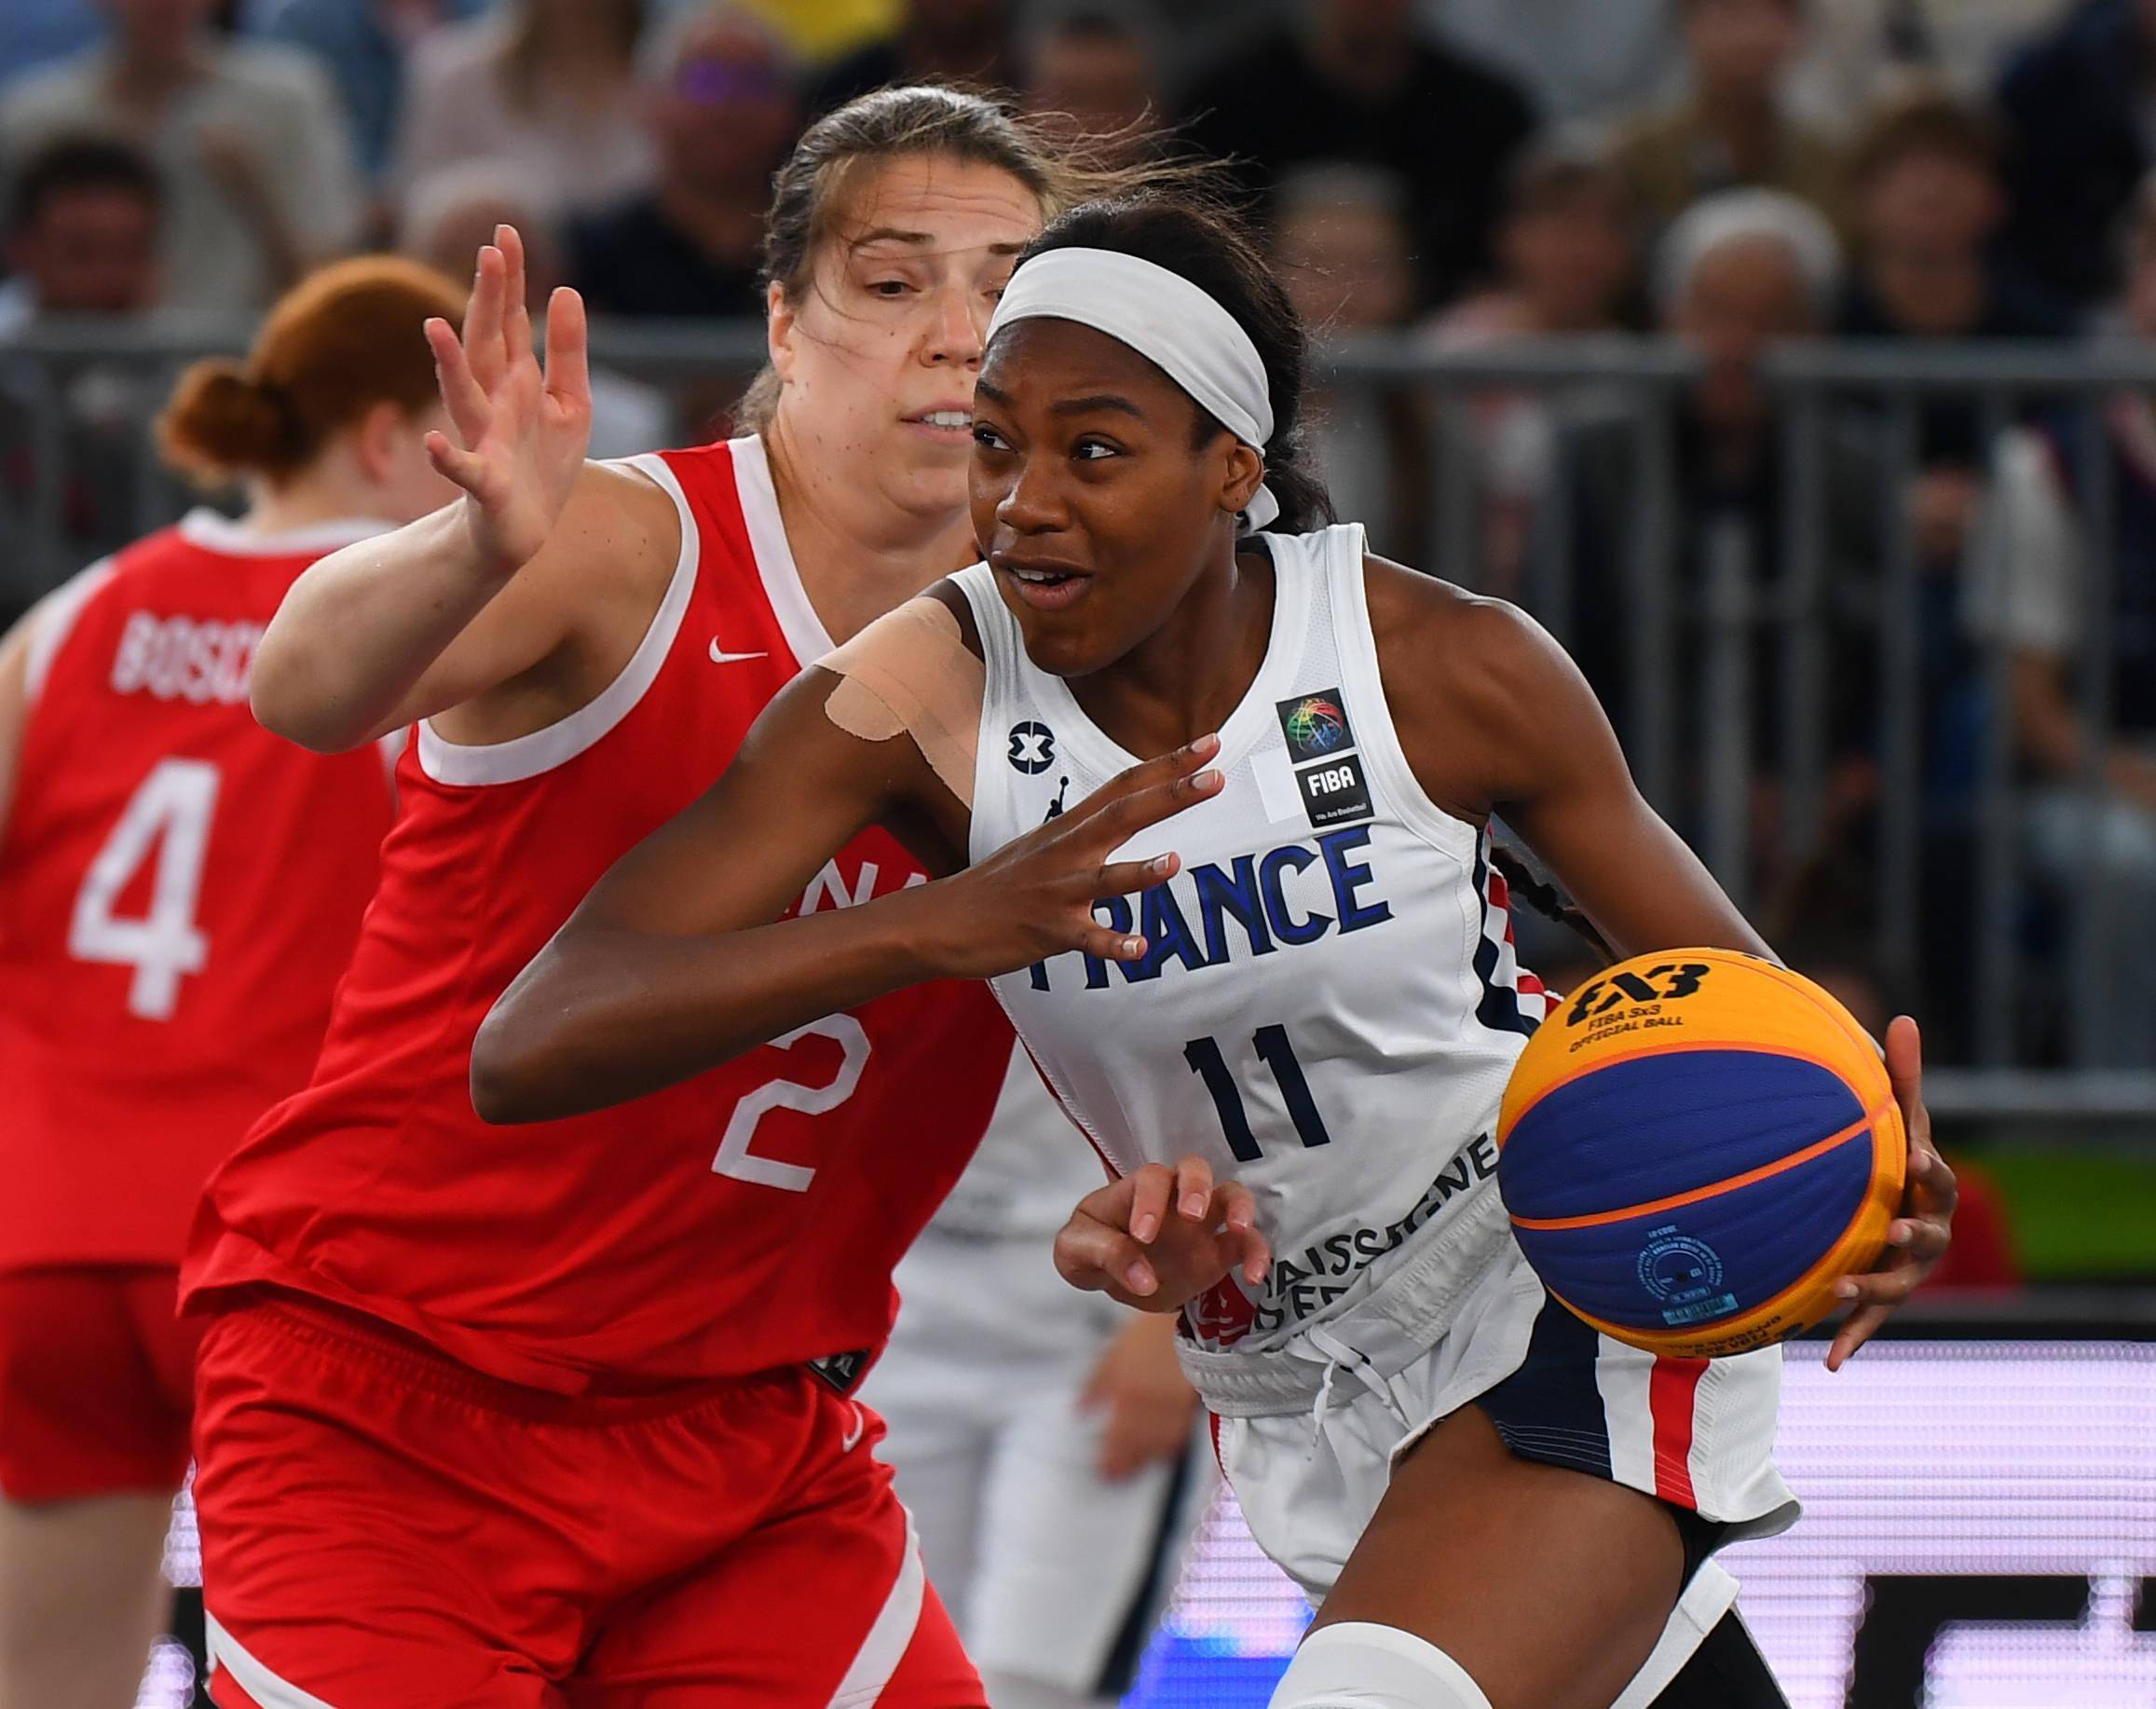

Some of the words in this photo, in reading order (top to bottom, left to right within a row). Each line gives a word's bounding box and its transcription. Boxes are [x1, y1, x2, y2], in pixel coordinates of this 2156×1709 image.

[1307, 765, 1356, 797] FIBA
[68, 757, 221, 1021] 4
[1031, 824, 1395, 992] RANCE
[1569, 1021, 1639, 1053] OFFICIAL
[1644, 1016, 1684, 1029] BALL
[1588, 1010, 1625, 1032] FIBA
[712, 1013, 872, 1193] 2
[1183, 1023, 1330, 1162] 11
